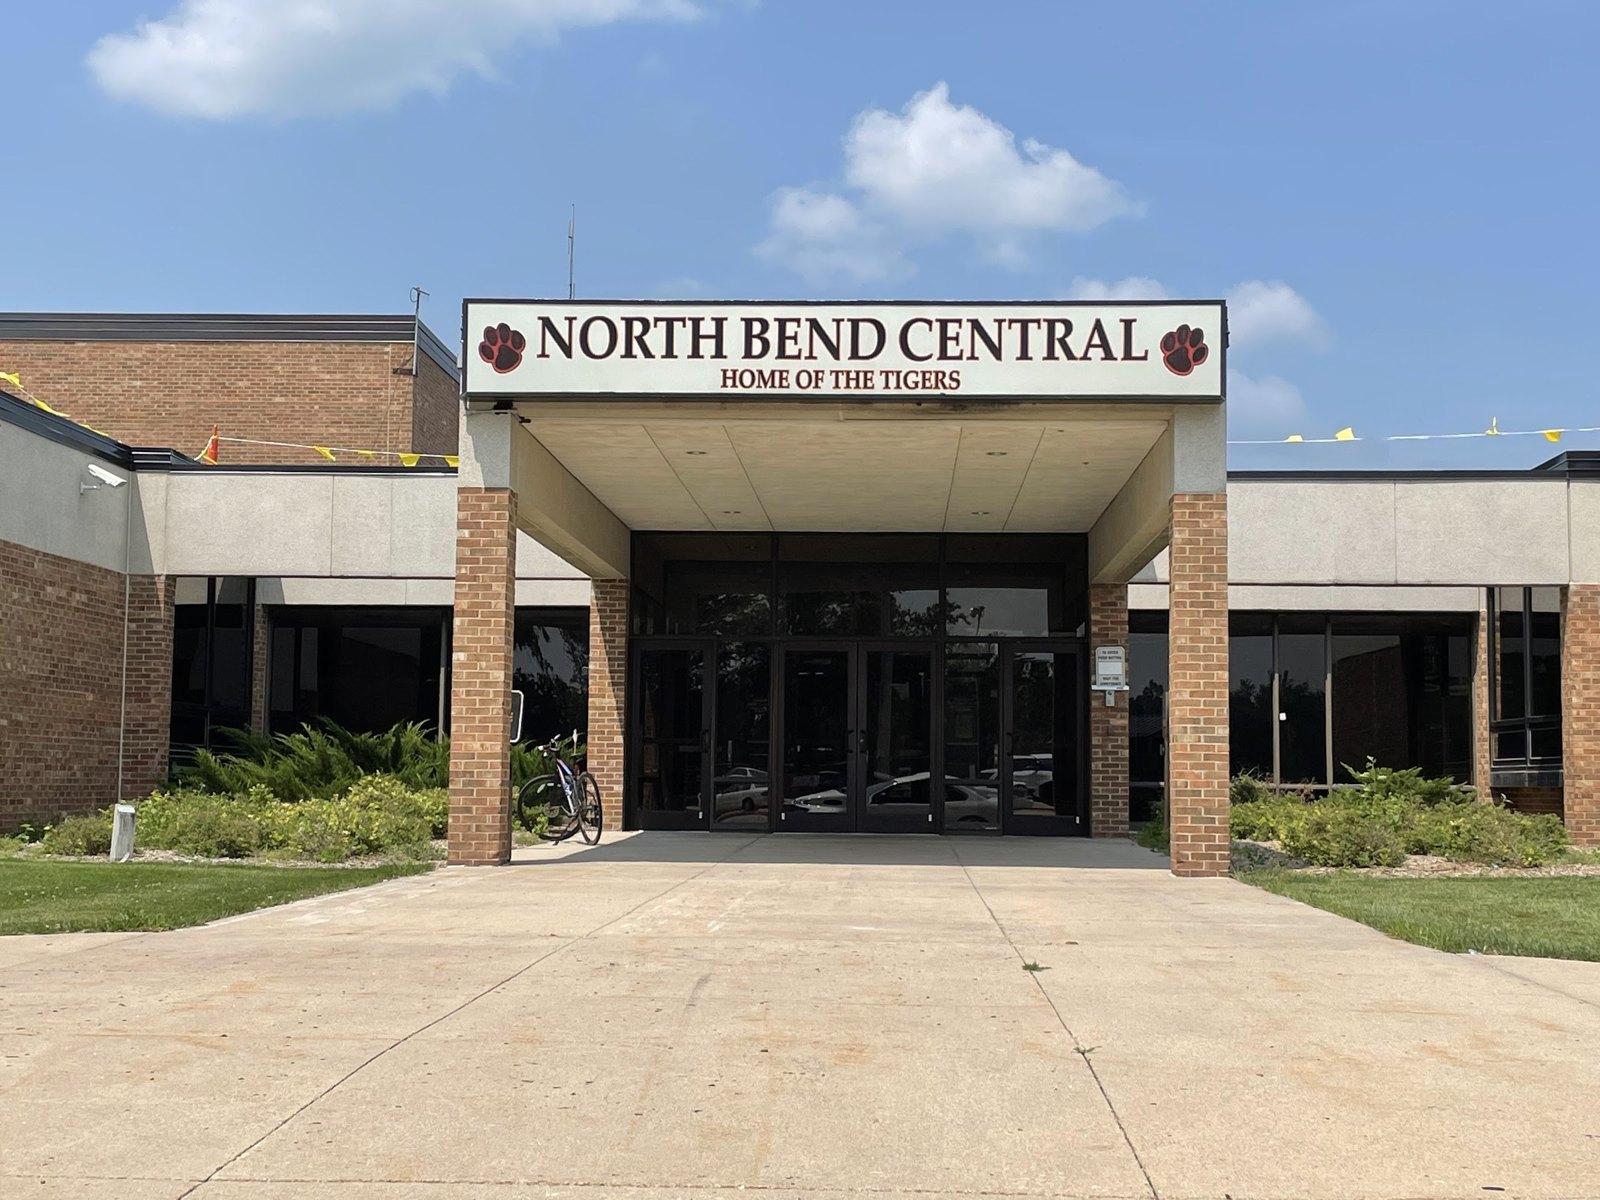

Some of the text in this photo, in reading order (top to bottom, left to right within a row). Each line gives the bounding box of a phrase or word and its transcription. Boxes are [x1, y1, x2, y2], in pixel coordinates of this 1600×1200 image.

[536, 316, 1149, 362] NORTH BEND CENTRAL
[720, 369, 961, 390] HOME OF THE TIGERS
